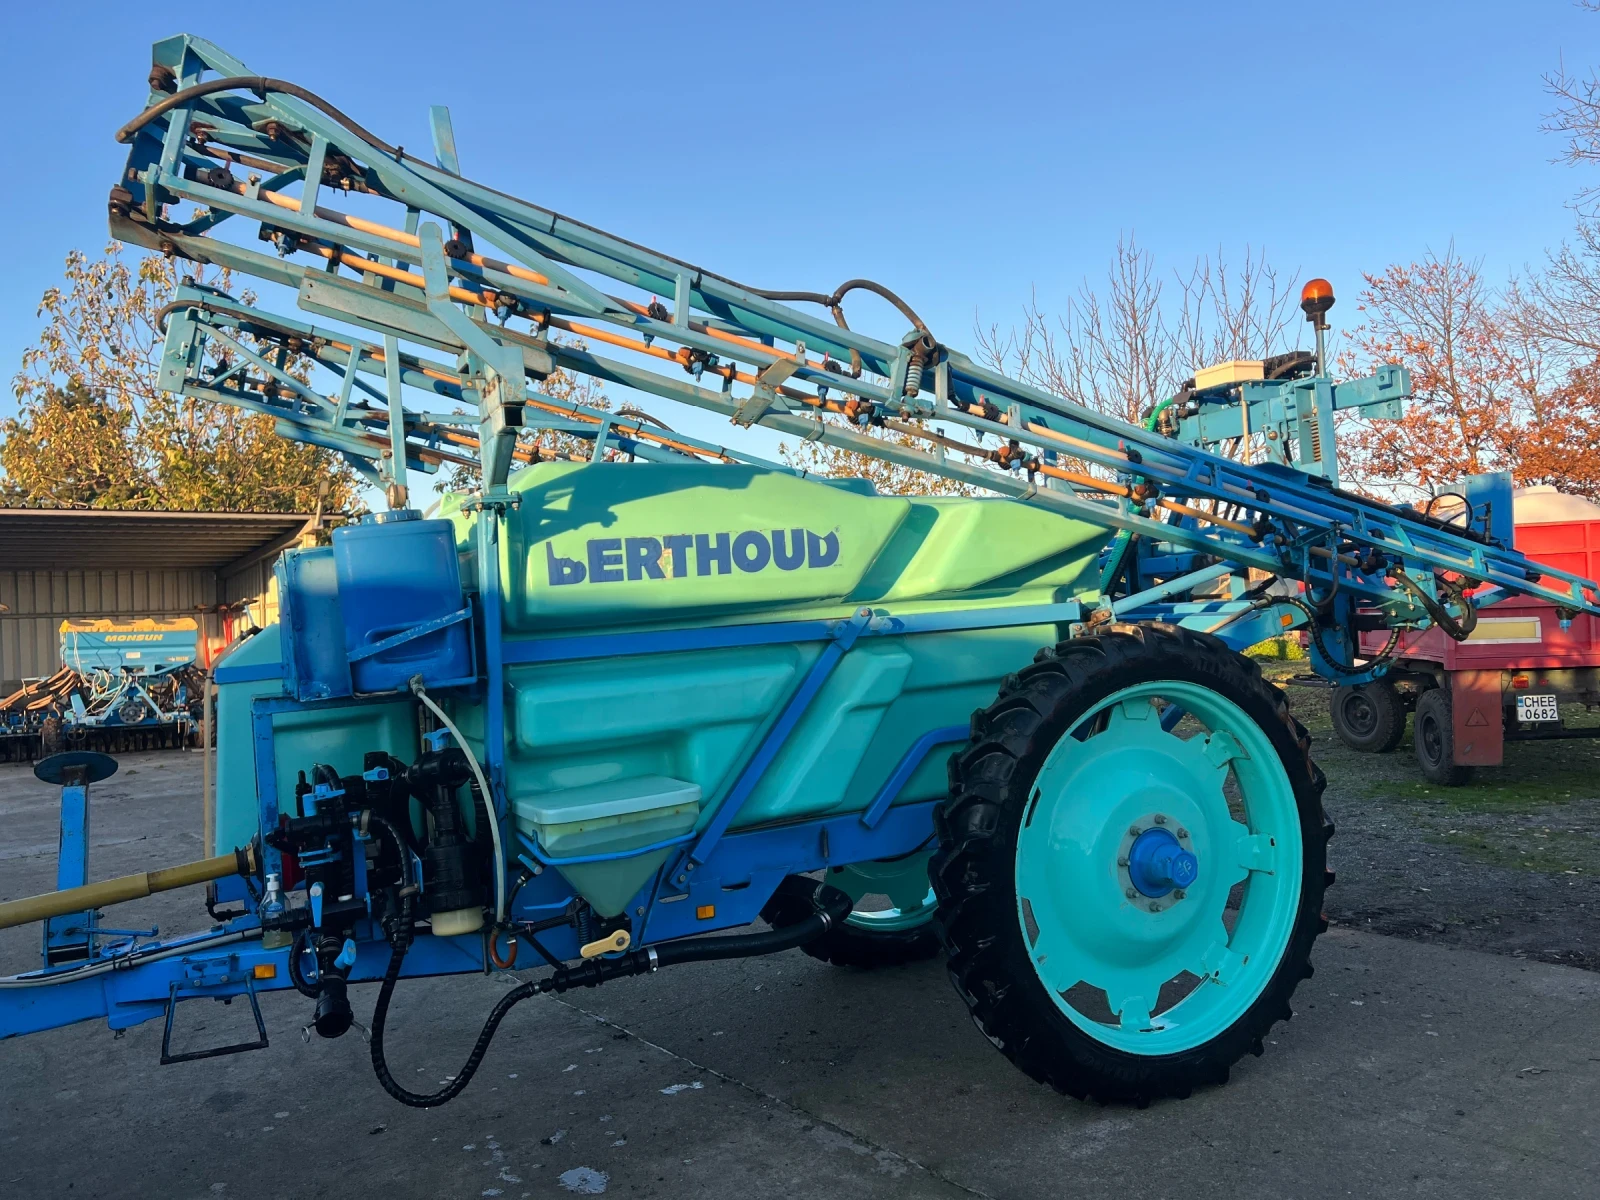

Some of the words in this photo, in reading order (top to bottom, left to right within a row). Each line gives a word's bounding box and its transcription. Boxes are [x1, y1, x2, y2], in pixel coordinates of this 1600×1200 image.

[105, 633, 164, 642] MONSUN
[1524, 696, 1556, 707] CHEE
[1525, 708, 1557, 719] 0682
